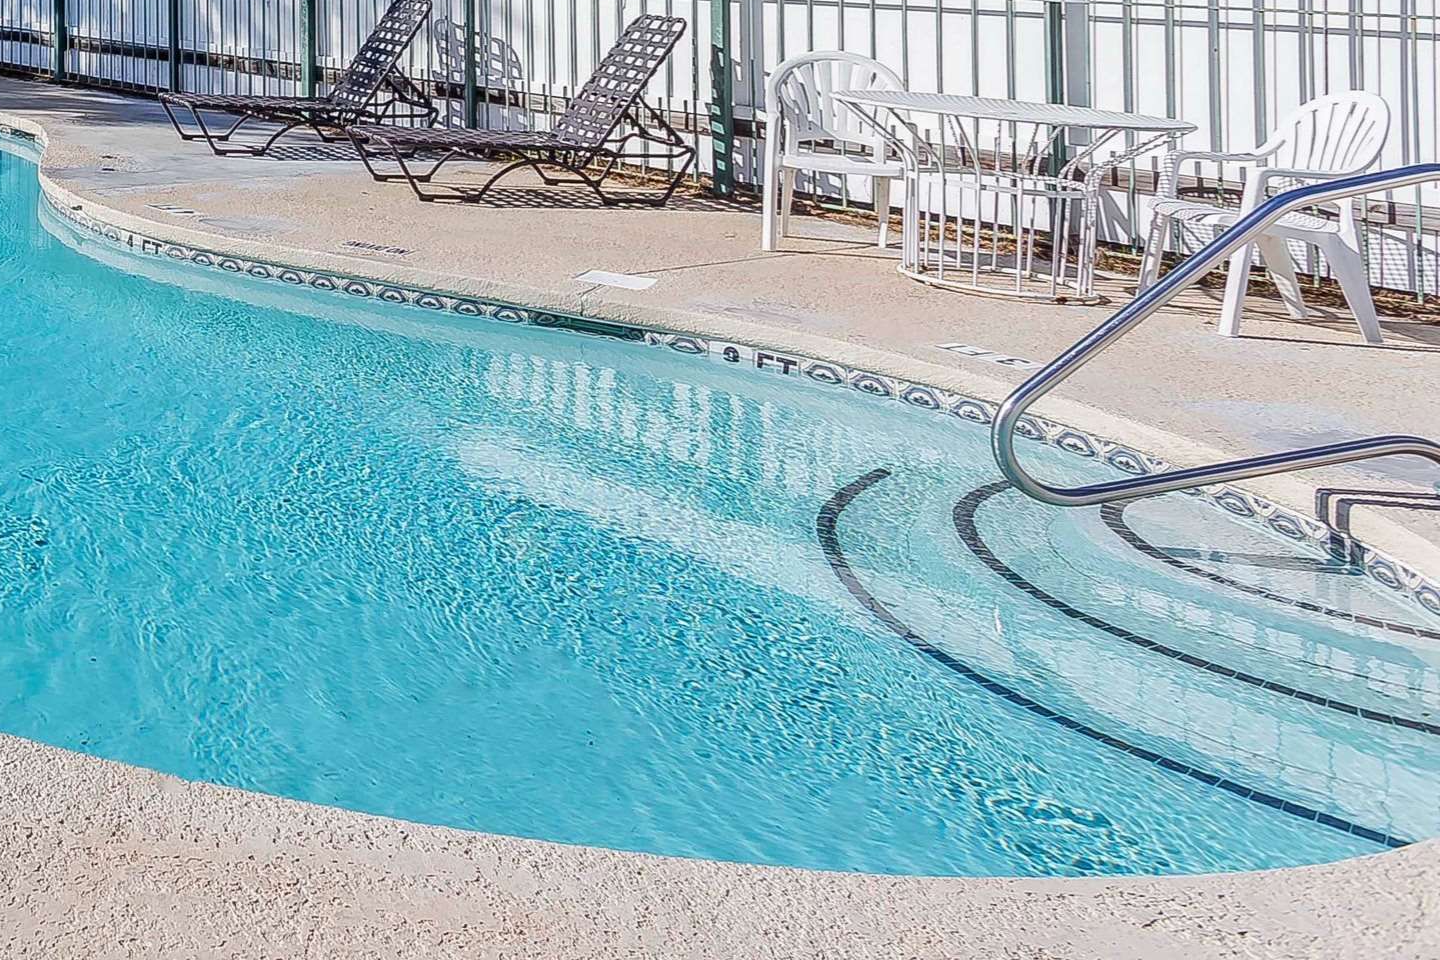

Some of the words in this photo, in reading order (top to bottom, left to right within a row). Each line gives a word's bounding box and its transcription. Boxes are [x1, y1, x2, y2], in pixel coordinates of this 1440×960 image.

[126, 234, 133, 247] 4
[141, 238, 163, 255] FT
[934, 345, 994, 357] FT
[756, 352, 798, 376] FT
[996, 358, 1031, 366] 3
